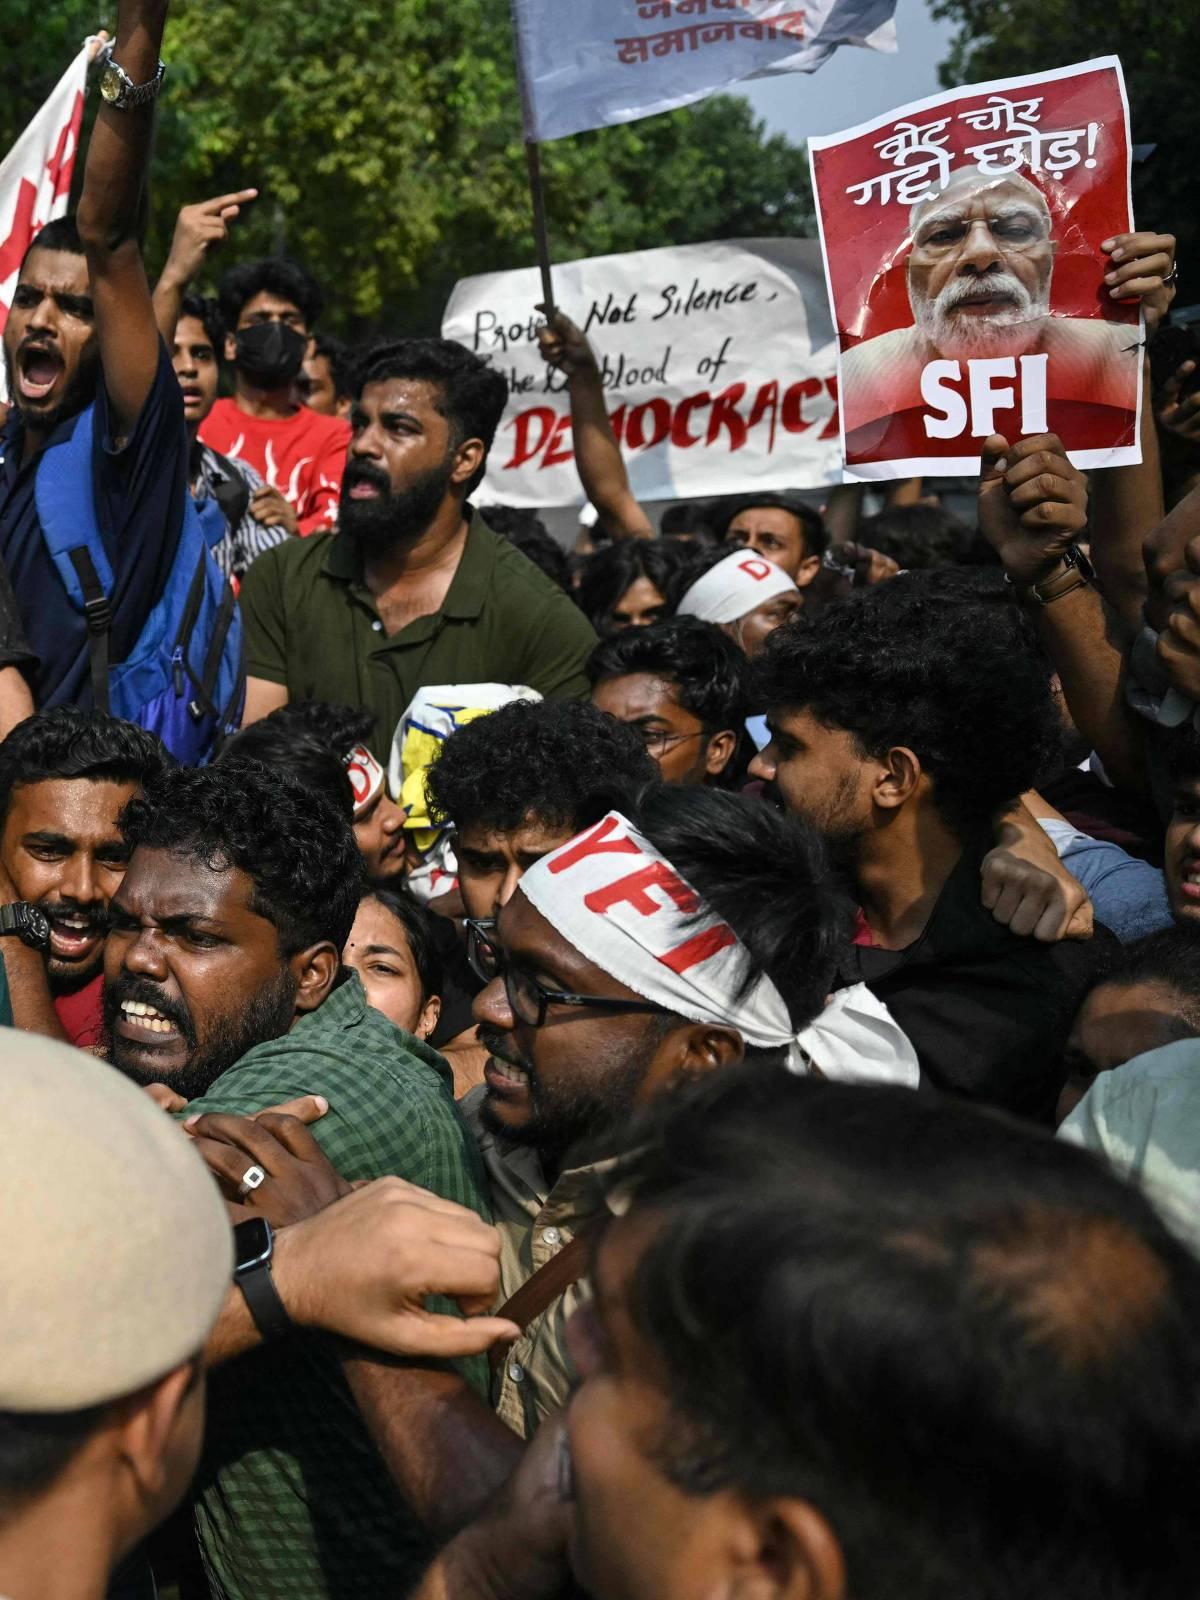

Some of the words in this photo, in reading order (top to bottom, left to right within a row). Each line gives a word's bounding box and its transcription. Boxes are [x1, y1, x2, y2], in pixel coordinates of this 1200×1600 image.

[614, 10, 806, 64] समाजवाद
[873, 120, 952, 160] वोट
[958, 96, 1043, 132] चोर
[845, 144, 955, 205] गद्दी
[964, 122, 1099, 180] छोड़!
[584, 293, 638, 333] Not
[696, 337, 732, 383] of
[920, 352, 1049, 439] SFI
[737, 560, 771, 581] D
